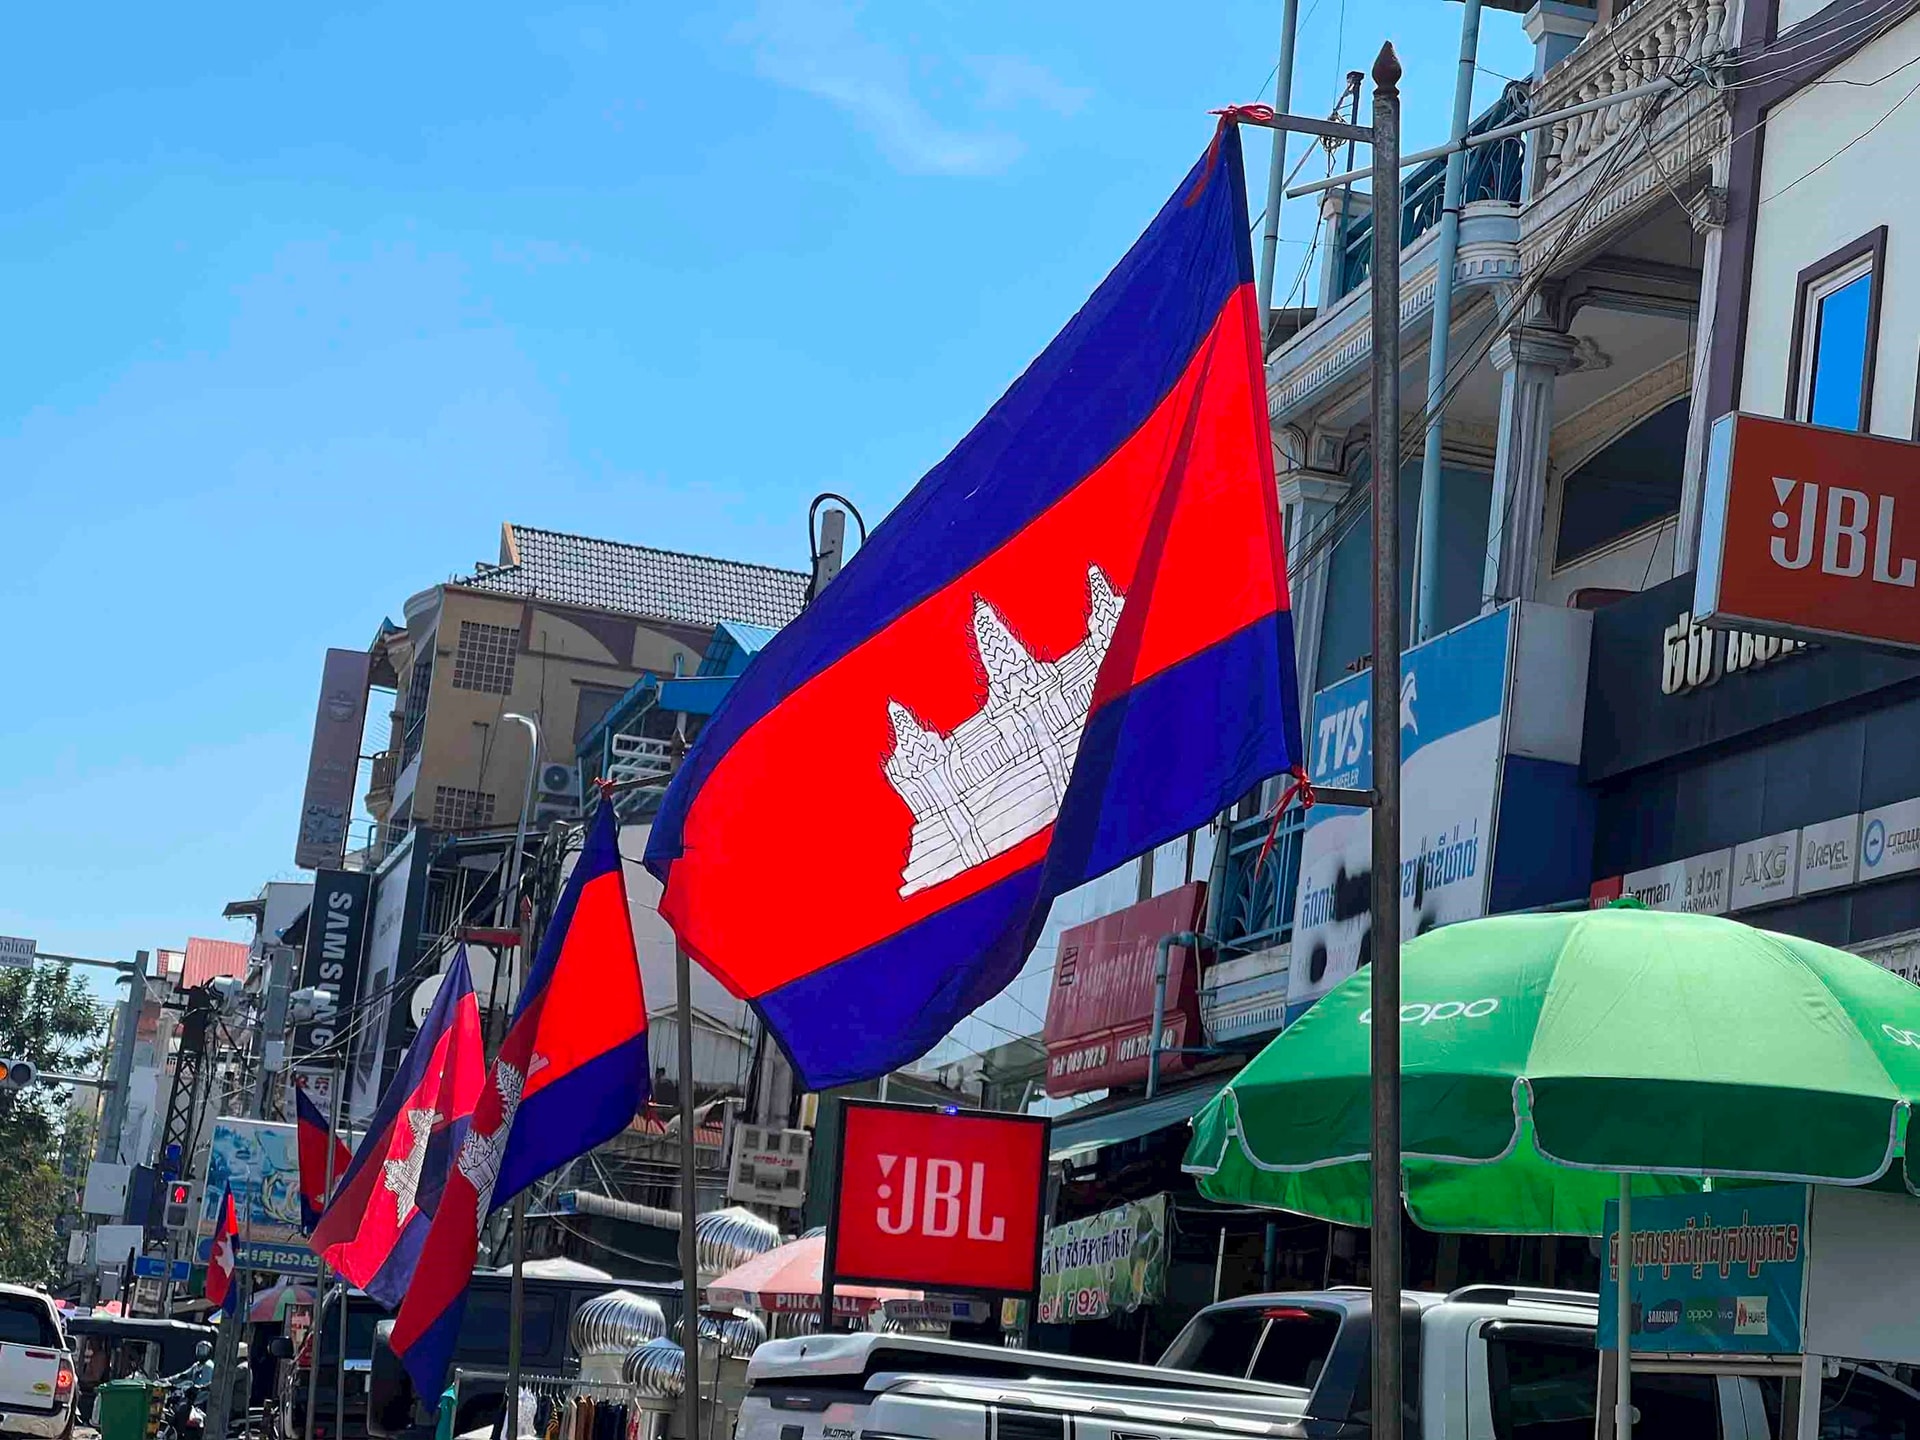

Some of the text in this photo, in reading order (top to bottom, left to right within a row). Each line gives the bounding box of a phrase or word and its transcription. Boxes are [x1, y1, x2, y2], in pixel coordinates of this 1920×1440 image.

[1769, 477, 1916, 588] JBL
[1316, 700, 1368, 777] TVS
[1739, 845, 1789, 886] AKG
[876, 1154, 1006, 1242] JBL
[1647, 1310, 1679, 1324] SAMSUNG
[1686, 1309, 1713, 1321] oppo
